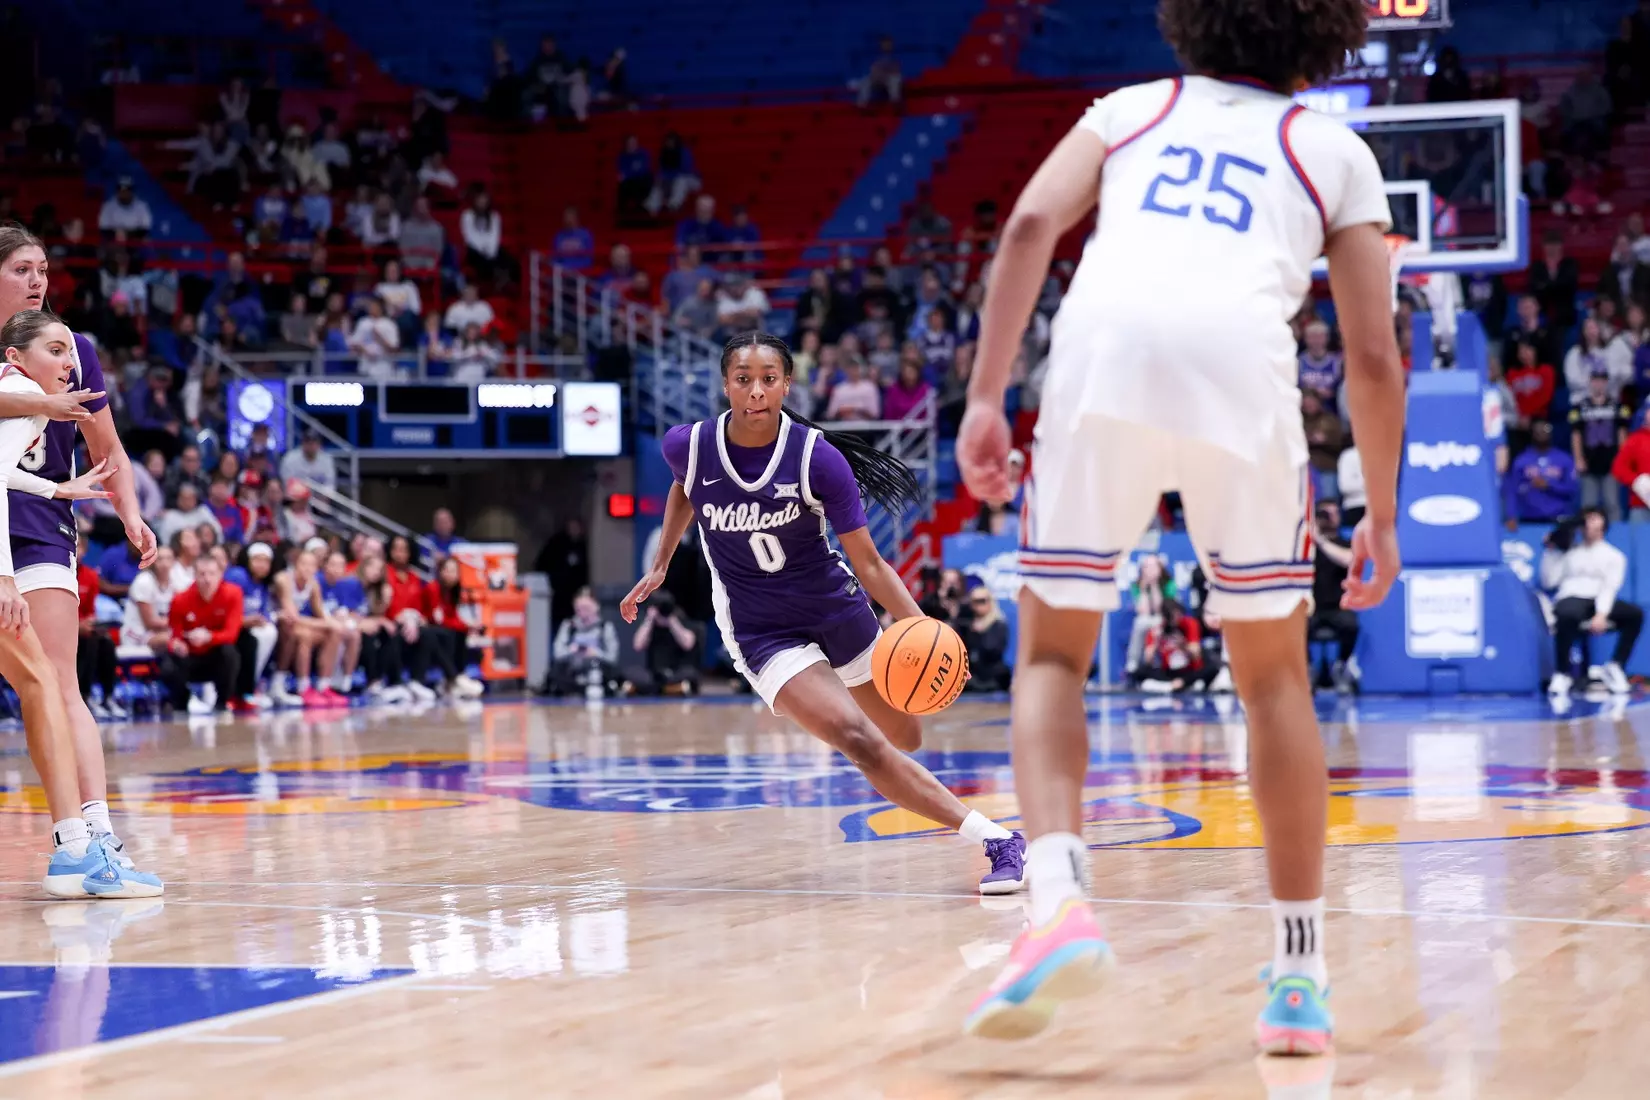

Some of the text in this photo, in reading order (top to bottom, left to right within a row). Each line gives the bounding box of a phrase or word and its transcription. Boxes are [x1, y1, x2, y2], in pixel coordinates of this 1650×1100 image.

[1140, 145, 1267, 233] 25
[702, 501, 801, 532] Wildcats
[748, 531, 787, 574] 0
